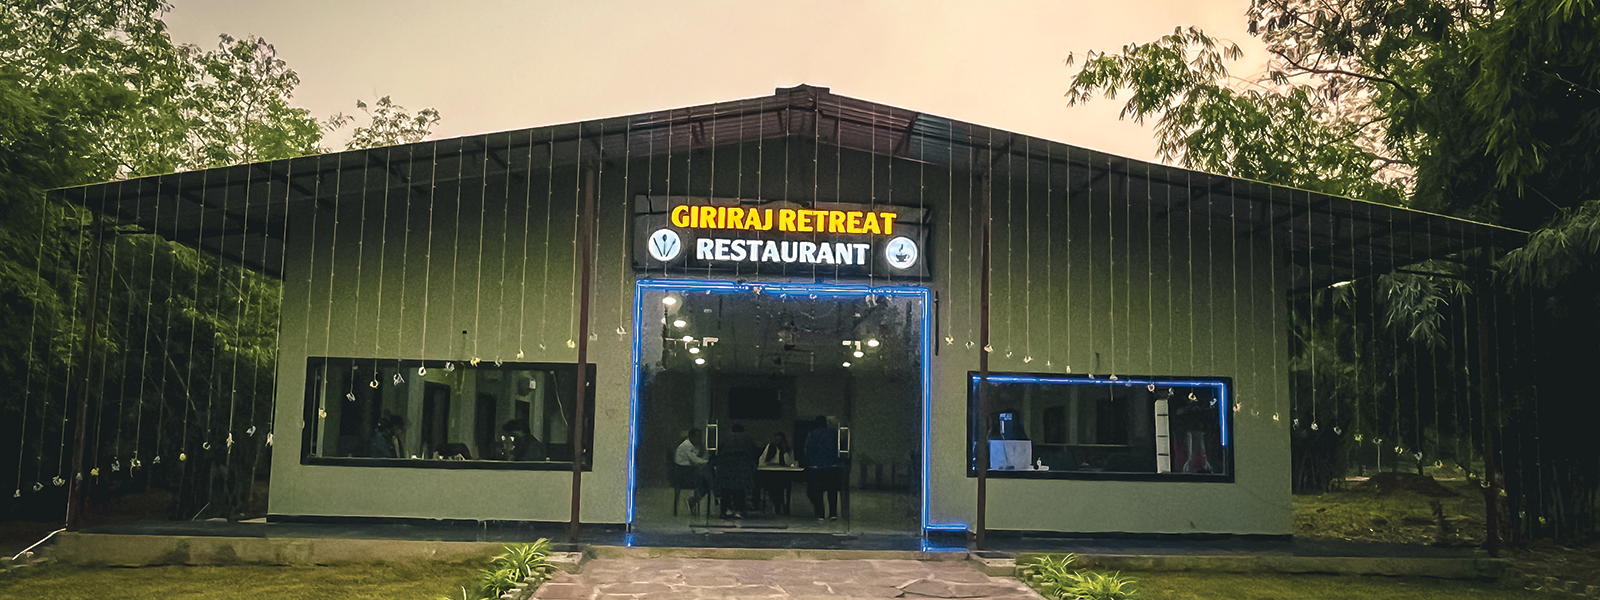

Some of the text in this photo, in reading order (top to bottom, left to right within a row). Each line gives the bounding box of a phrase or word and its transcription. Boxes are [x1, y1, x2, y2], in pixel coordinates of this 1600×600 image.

[671, 205, 898, 235] GIRIRAJ RETREAT
[696, 238, 870, 265] RESTAURANT
